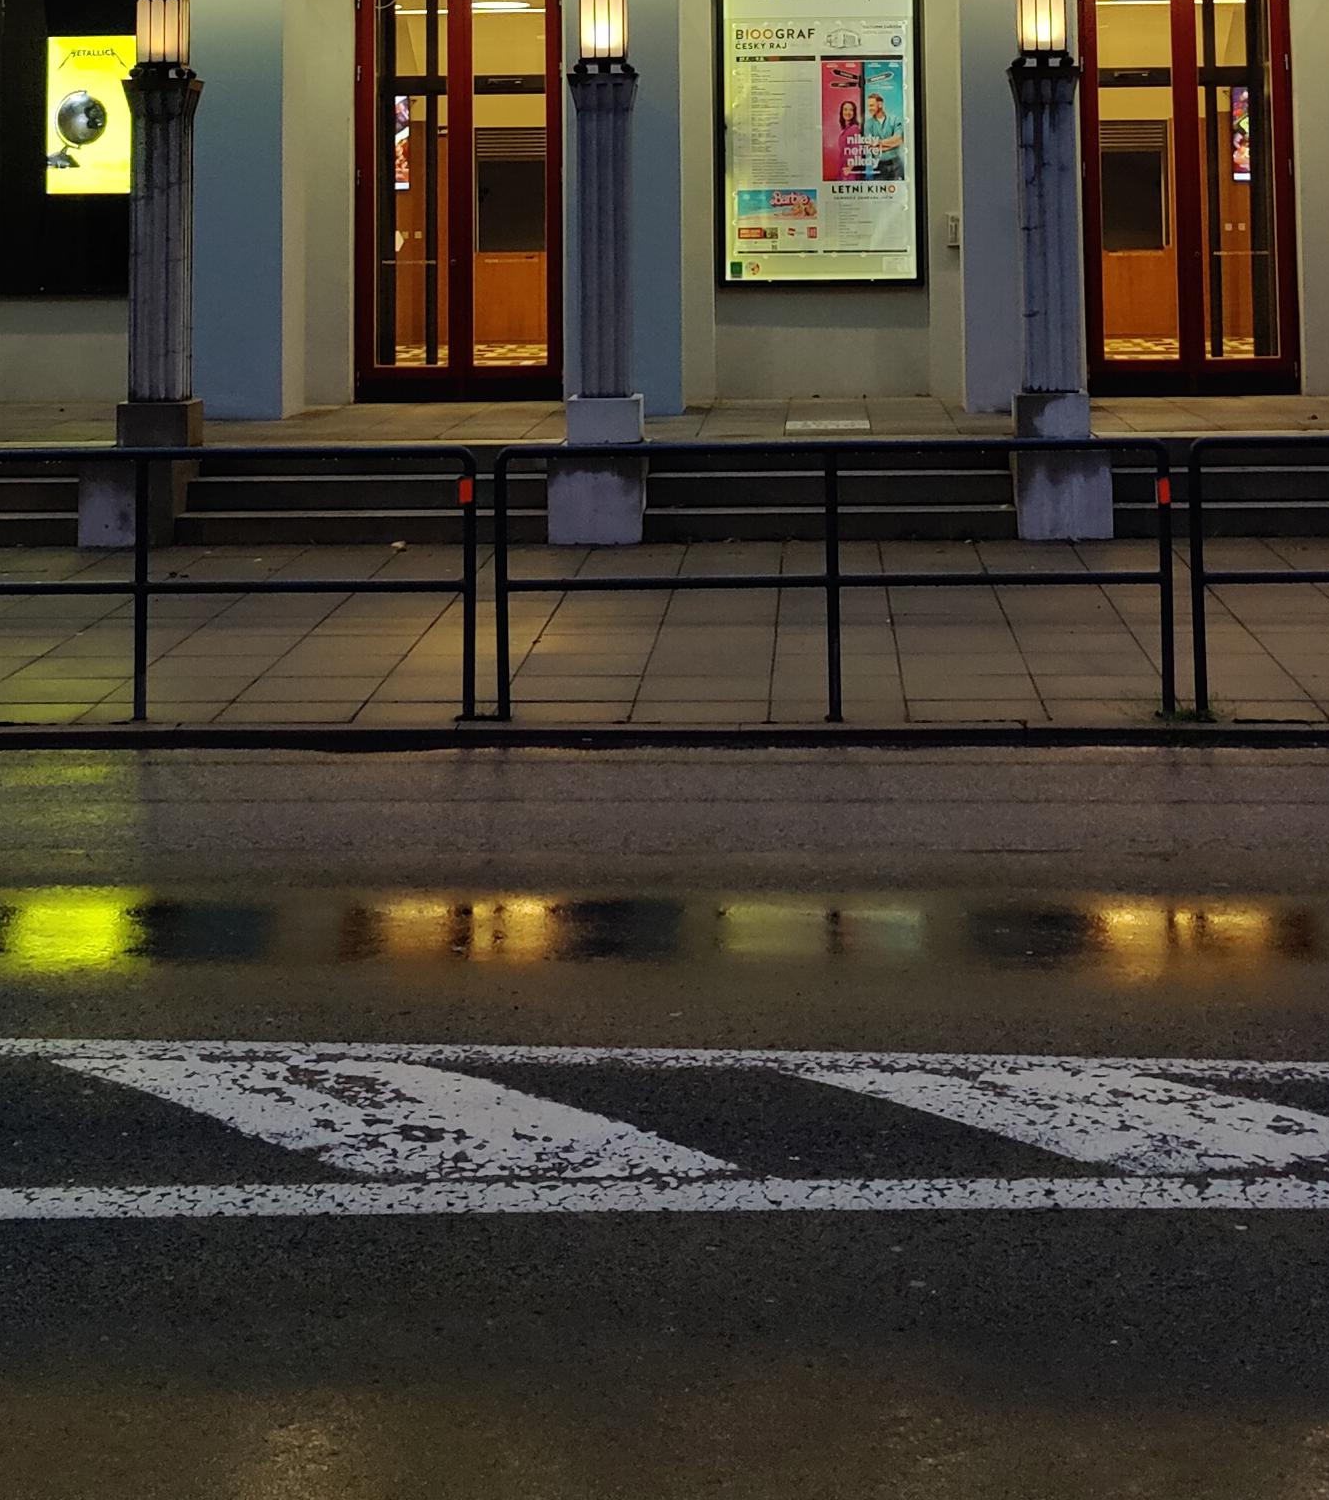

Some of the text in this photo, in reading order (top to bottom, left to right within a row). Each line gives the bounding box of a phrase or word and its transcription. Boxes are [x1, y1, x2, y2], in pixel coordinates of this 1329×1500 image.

[735, 28, 815, 40] BIOOGRAF
[832, 183, 896, 193] LETNÍ KINO
